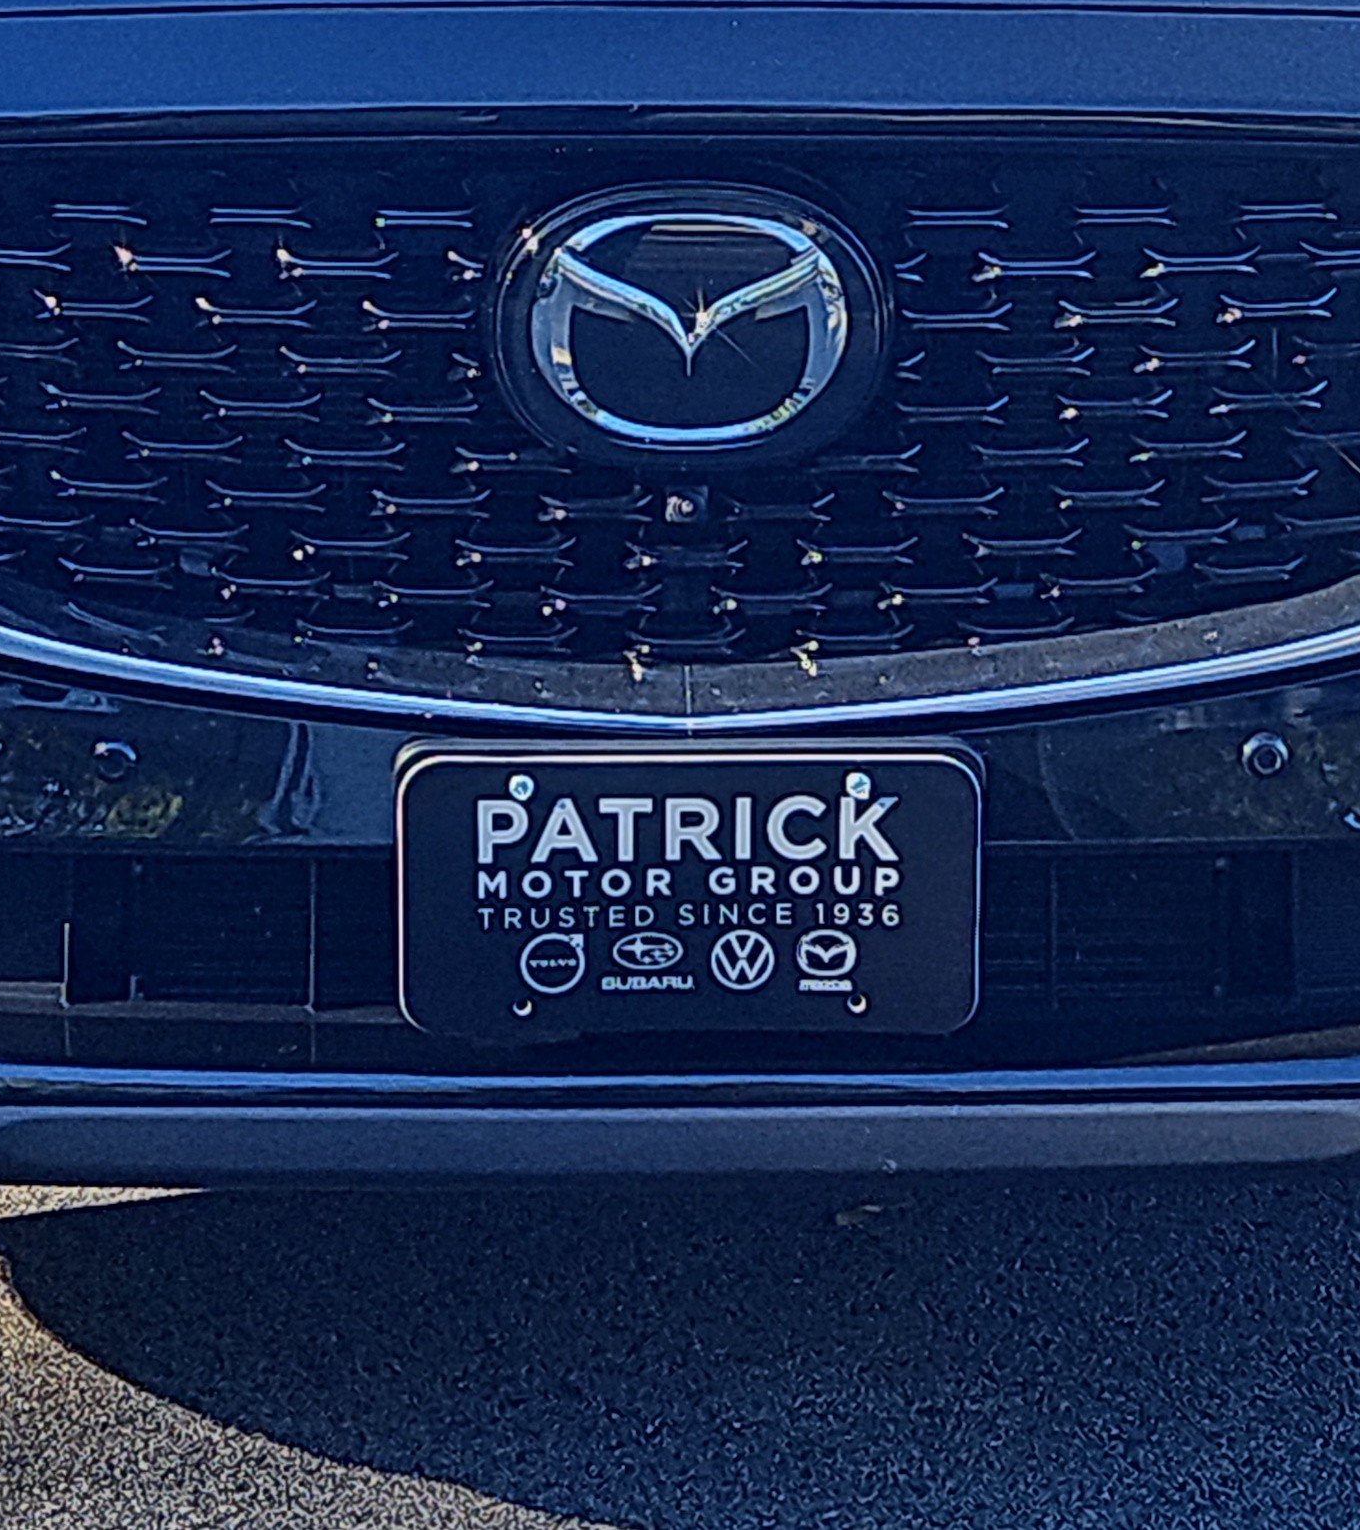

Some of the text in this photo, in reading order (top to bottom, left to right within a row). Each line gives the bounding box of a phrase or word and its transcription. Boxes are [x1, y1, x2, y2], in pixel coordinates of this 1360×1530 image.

[477, 795, 900, 864] PATRICK
[478, 865, 901, 900] MOTOR GROUP
[477, 902, 901, 931] TRUSTED SINCE 1936
[601, 974, 694, 991] SUBARU
